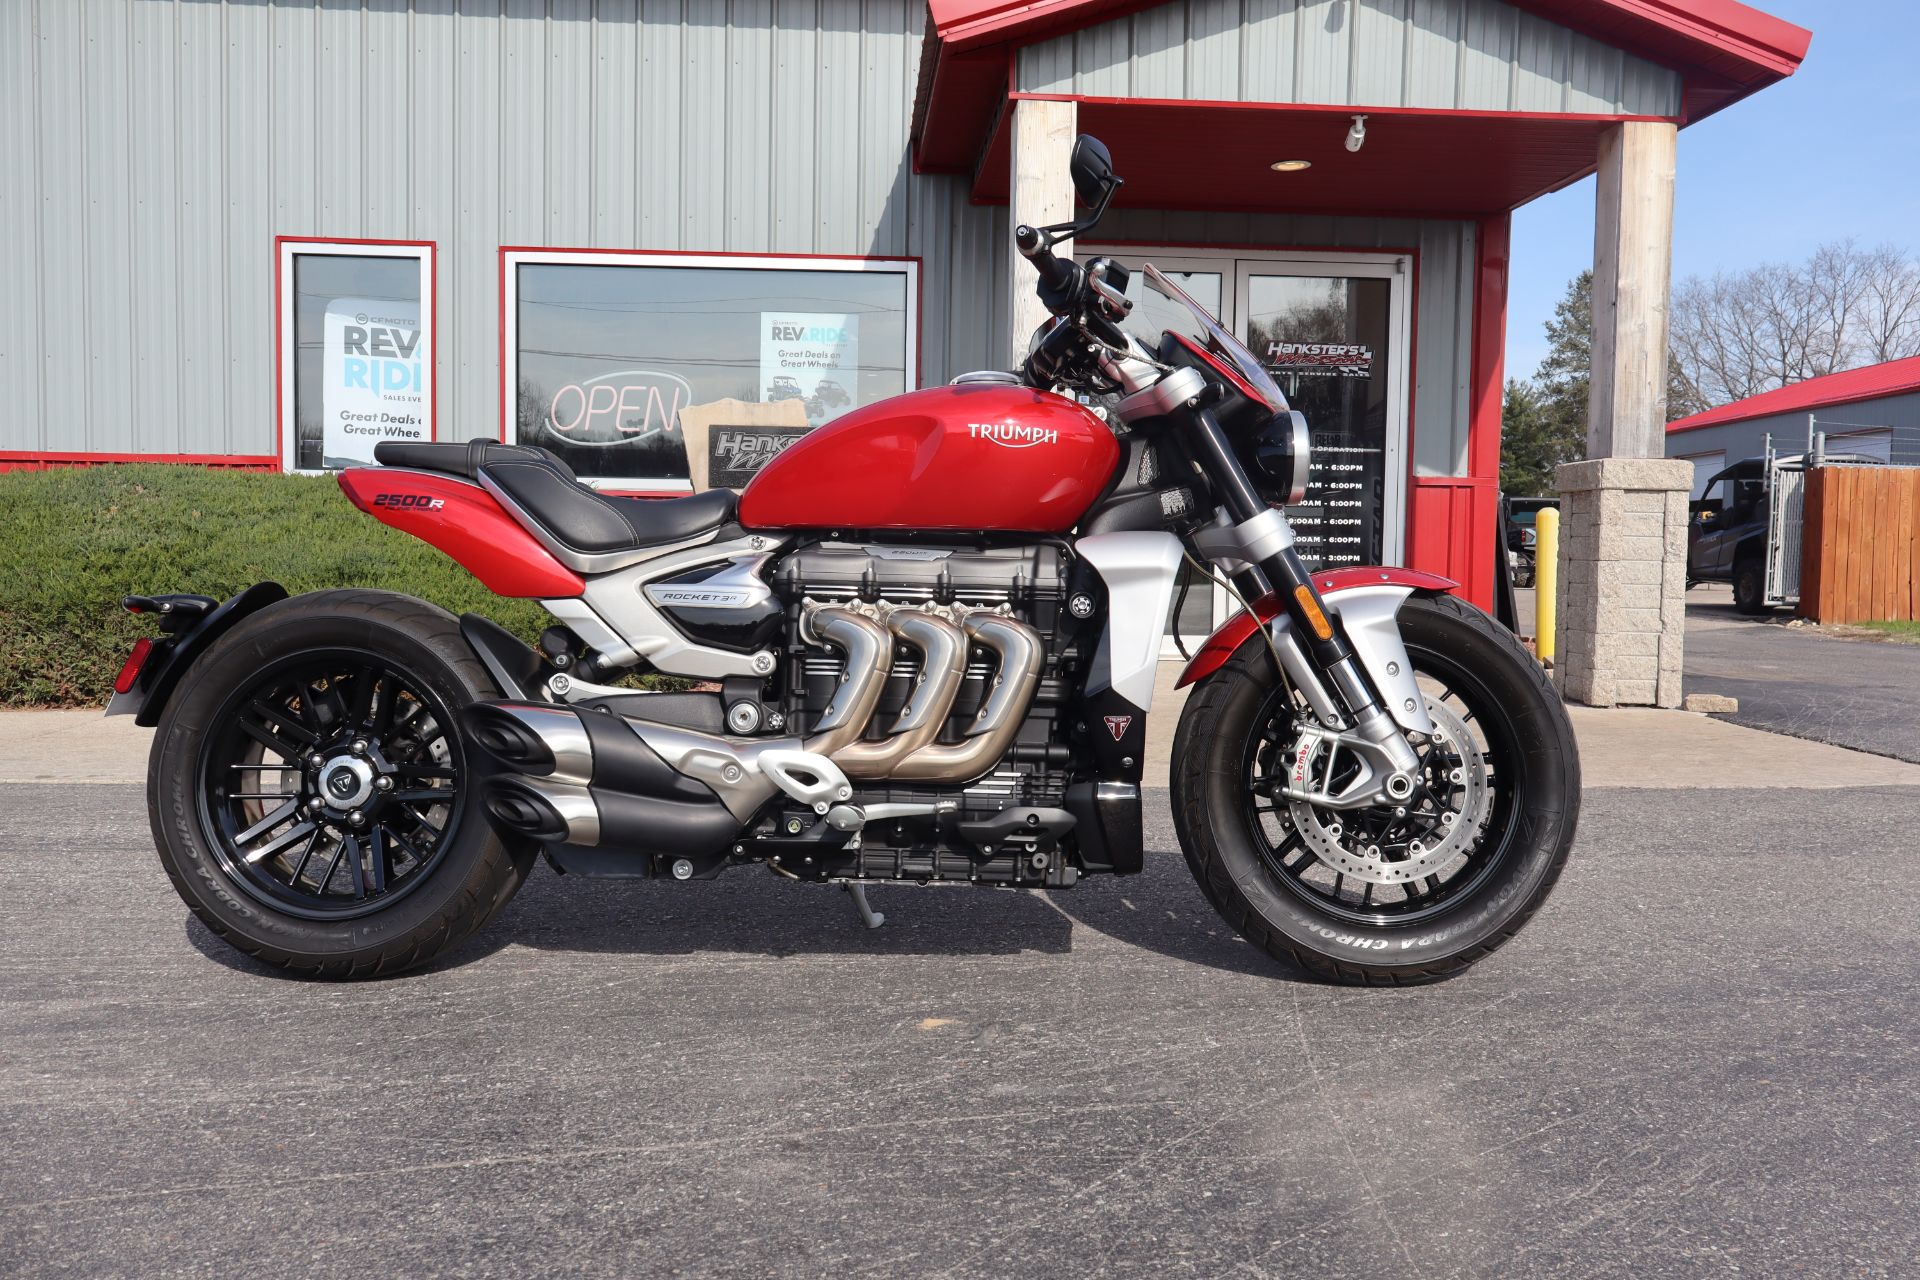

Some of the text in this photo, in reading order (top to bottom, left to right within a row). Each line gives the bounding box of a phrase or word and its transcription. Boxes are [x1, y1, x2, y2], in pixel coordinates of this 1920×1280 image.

[370, 317, 416, 326] CFMOTO
[344, 325, 421, 359] REV
[772, 326, 804, 341] REV
[810, 328, 848, 344] RIDE
[778, 349, 803, 358] Great
[805, 350, 828, 359] Deals
[781, 360, 839, 369] Great Wheels
[383, 394, 406, 402] SALES
[551, 384, 680, 432] OPEN
[340, 410, 379, 422] Great
[380, 413, 415, 425] Deals
[343, 424, 421, 438] Great Whee
[967, 423, 1057, 448] TRIUMPH
[373, 493, 445, 508] 2500R
[663, 593, 719, 601] ROCKET
[1293, 744, 1310, 782] brembo
